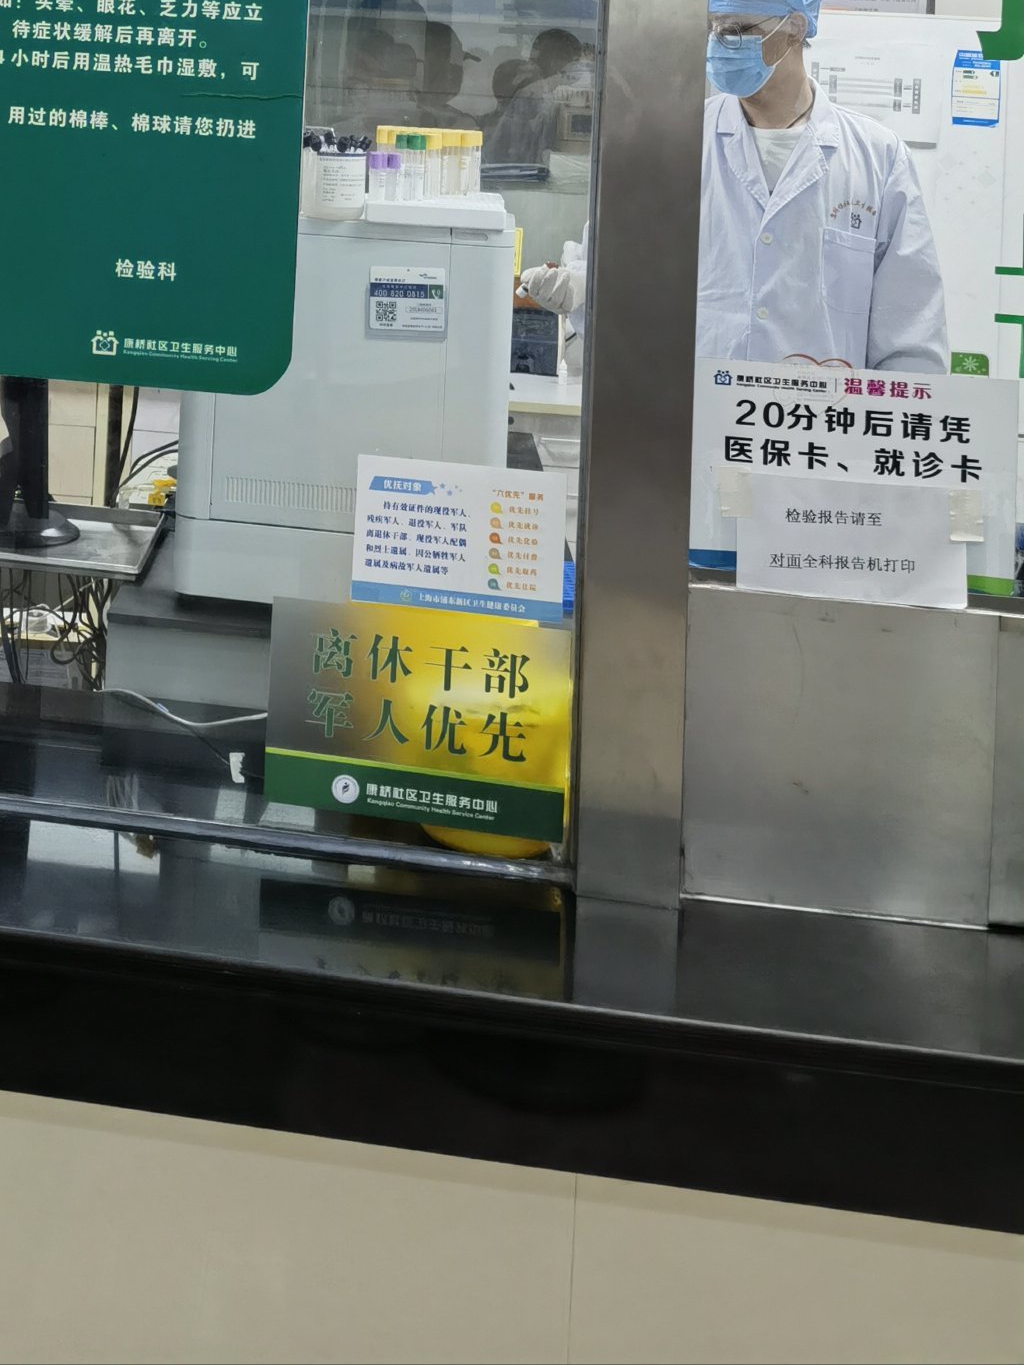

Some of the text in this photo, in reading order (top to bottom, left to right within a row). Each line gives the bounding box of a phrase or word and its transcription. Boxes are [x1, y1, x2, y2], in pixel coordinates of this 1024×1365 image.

[115, 258, 176, 281] 检验科
[844, 378, 931, 399] 温馨提示
[736, 400, 970, 444] 20分钟后请凭
[725, 436, 982, 483] 医保卡、就诊卡
[382, 479, 424, 493] 优抚对象
[786, 508, 881, 526] 检验报告请至
[769, 553, 915, 573] 对面全科报告机打印
[312, 628, 530, 699] 离休干部
[305, 689, 527, 762] 军人优先
[365, 783, 500, 813] 康桥社区卫生服务中心
